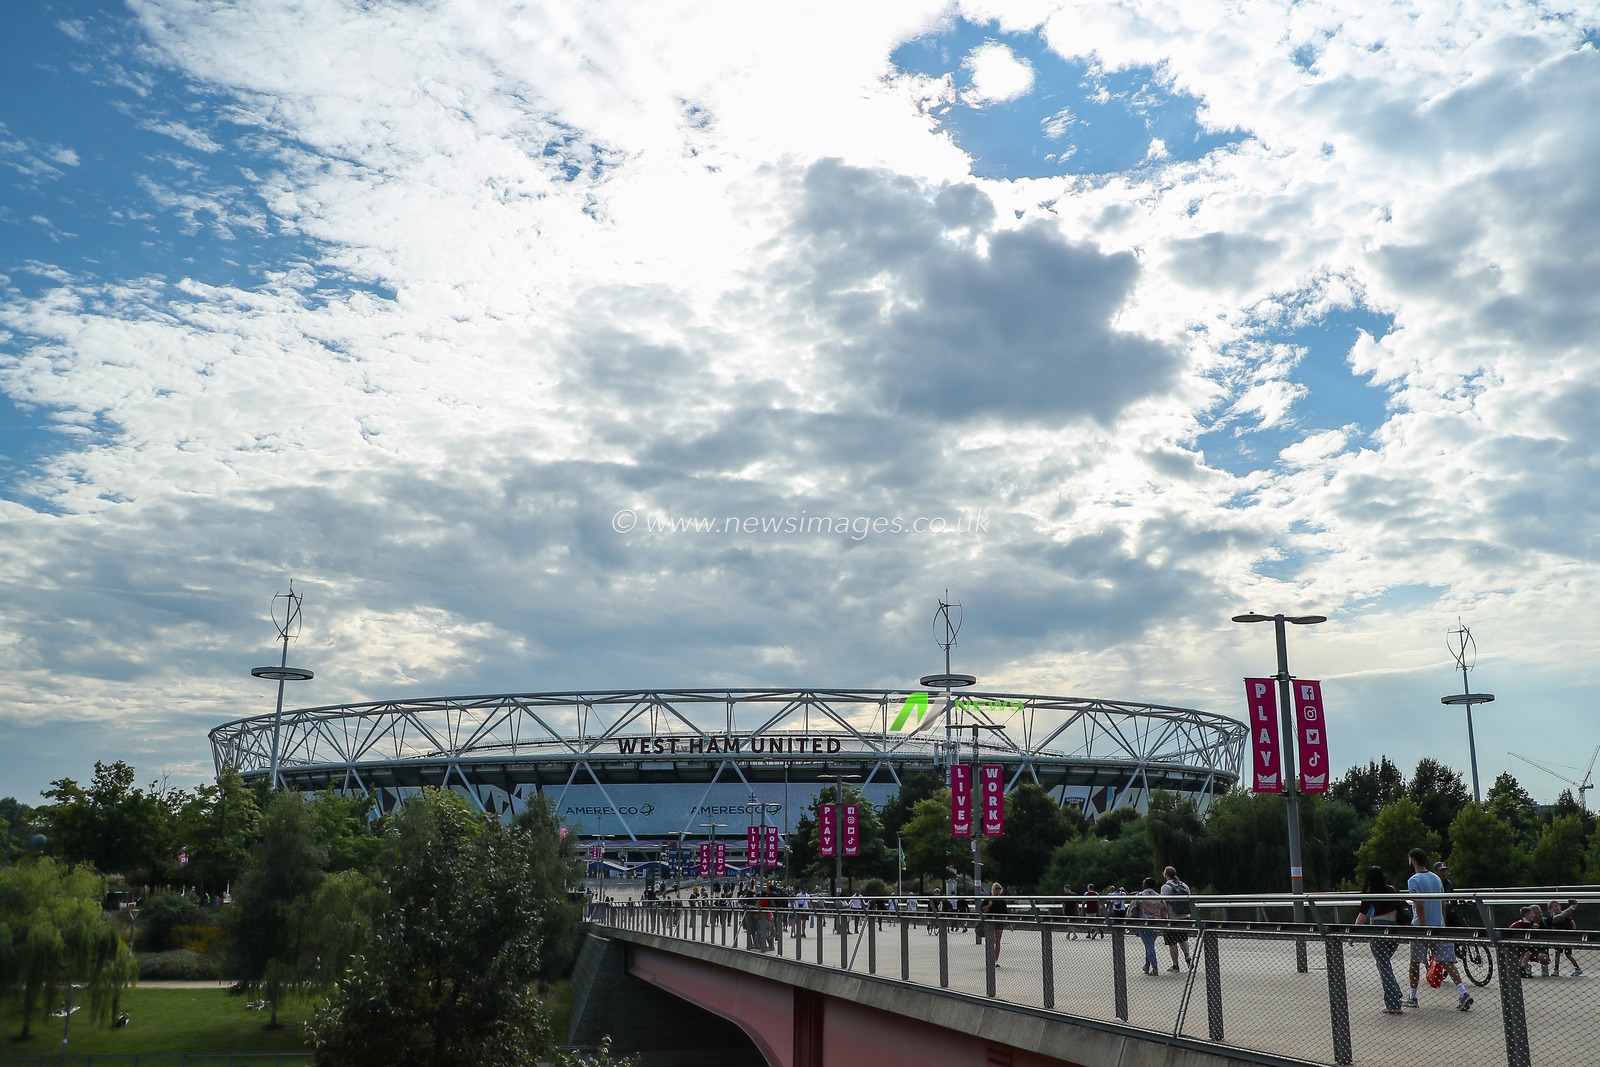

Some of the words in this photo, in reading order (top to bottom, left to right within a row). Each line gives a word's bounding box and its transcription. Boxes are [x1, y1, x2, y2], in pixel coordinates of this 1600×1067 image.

[618, 738, 680, 754] WEST
[689, 738, 741, 754] HAM
[751, 737, 841, 754] UNITED
[1255, 683, 1272, 767] PLAY
[690, 806, 763, 815] AMERESCO
[957, 768, 966, 820] LIVE
[986, 768, 999, 820] WORK
[768, 828, 776, 858] WORK
